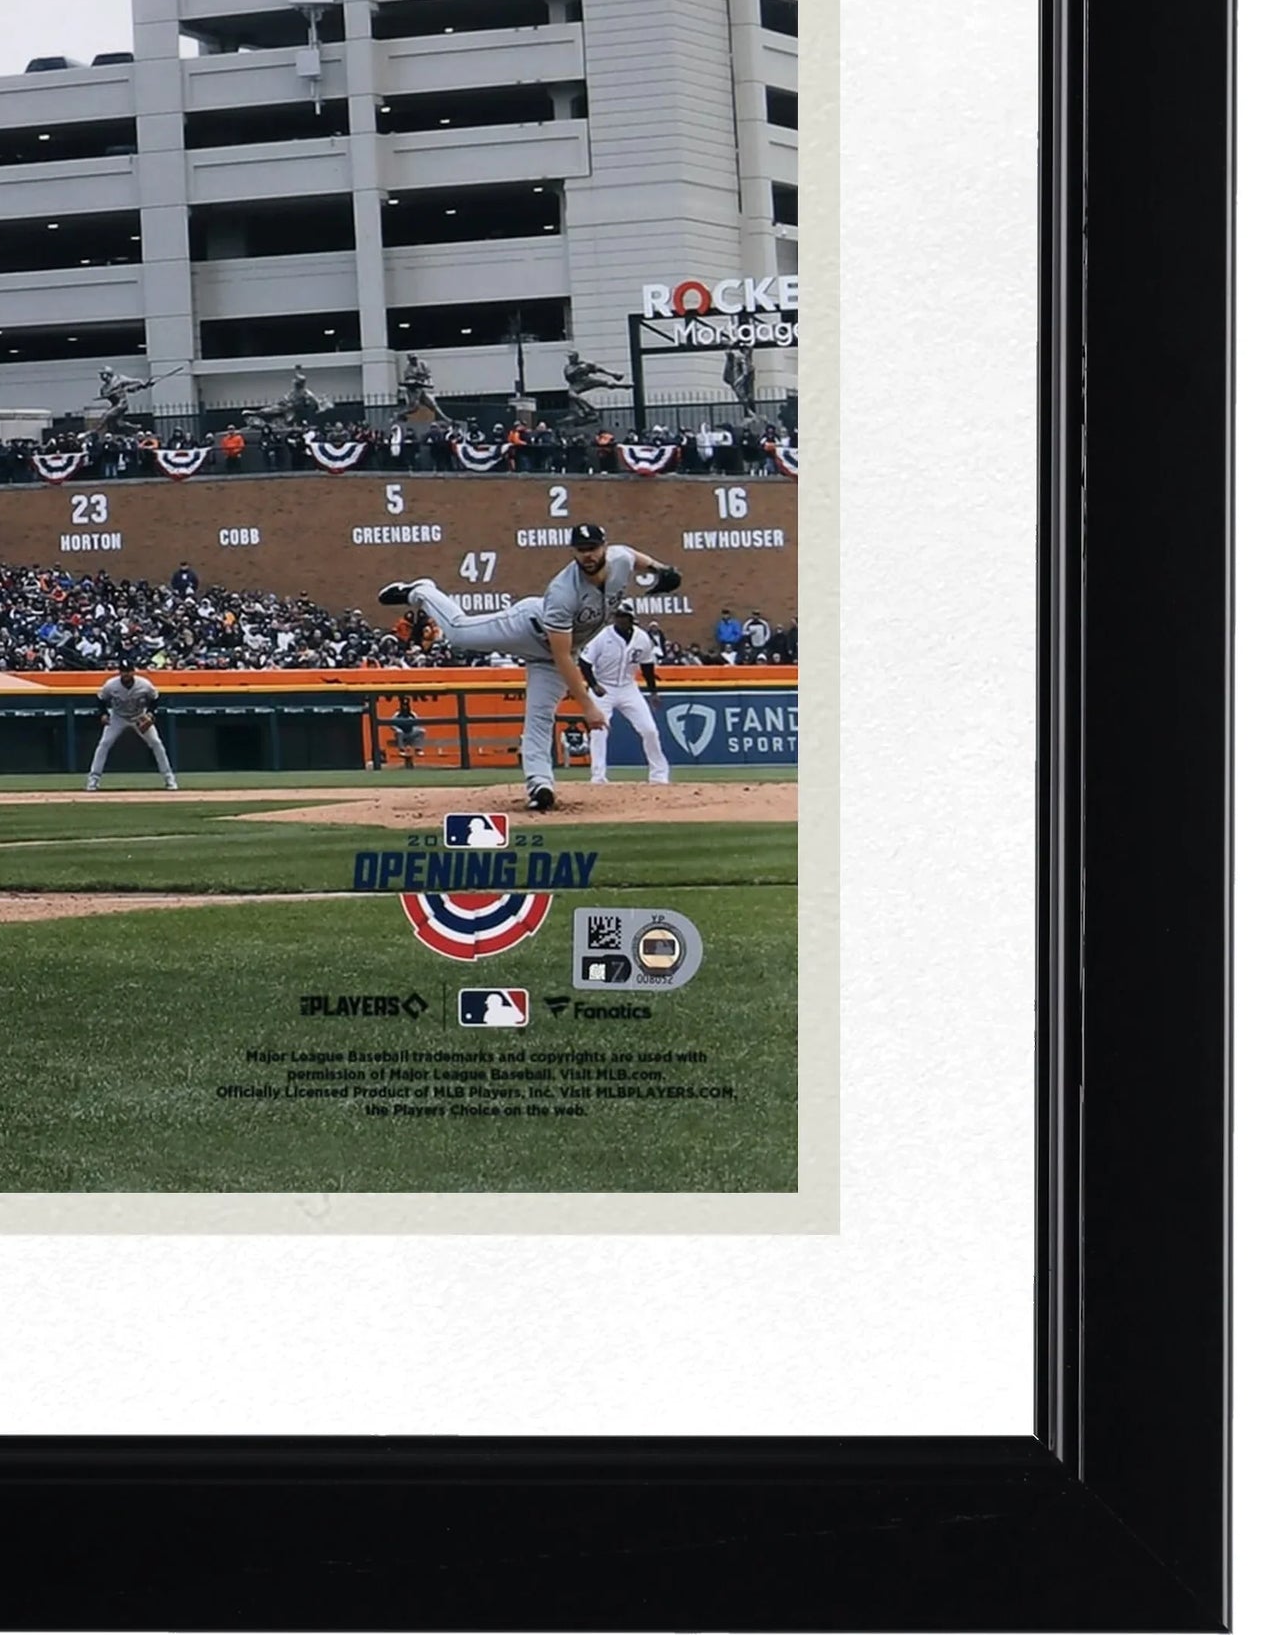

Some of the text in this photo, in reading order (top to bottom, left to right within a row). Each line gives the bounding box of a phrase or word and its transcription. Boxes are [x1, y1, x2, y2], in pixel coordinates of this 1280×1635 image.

[71, 494, 107, 524] 23
[386, 484, 404, 514] 5
[549, 486, 568, 517] 2
[715, 487, 748, 519] 16
[61, 533, 121, 551] HORTON
[219, 528, 259, 546] COBB
[352, 526, 441, 544] GREENBERG
[683, 530, 784, 549] NEWHOUSER
[460, 552, 496, 582] 47
